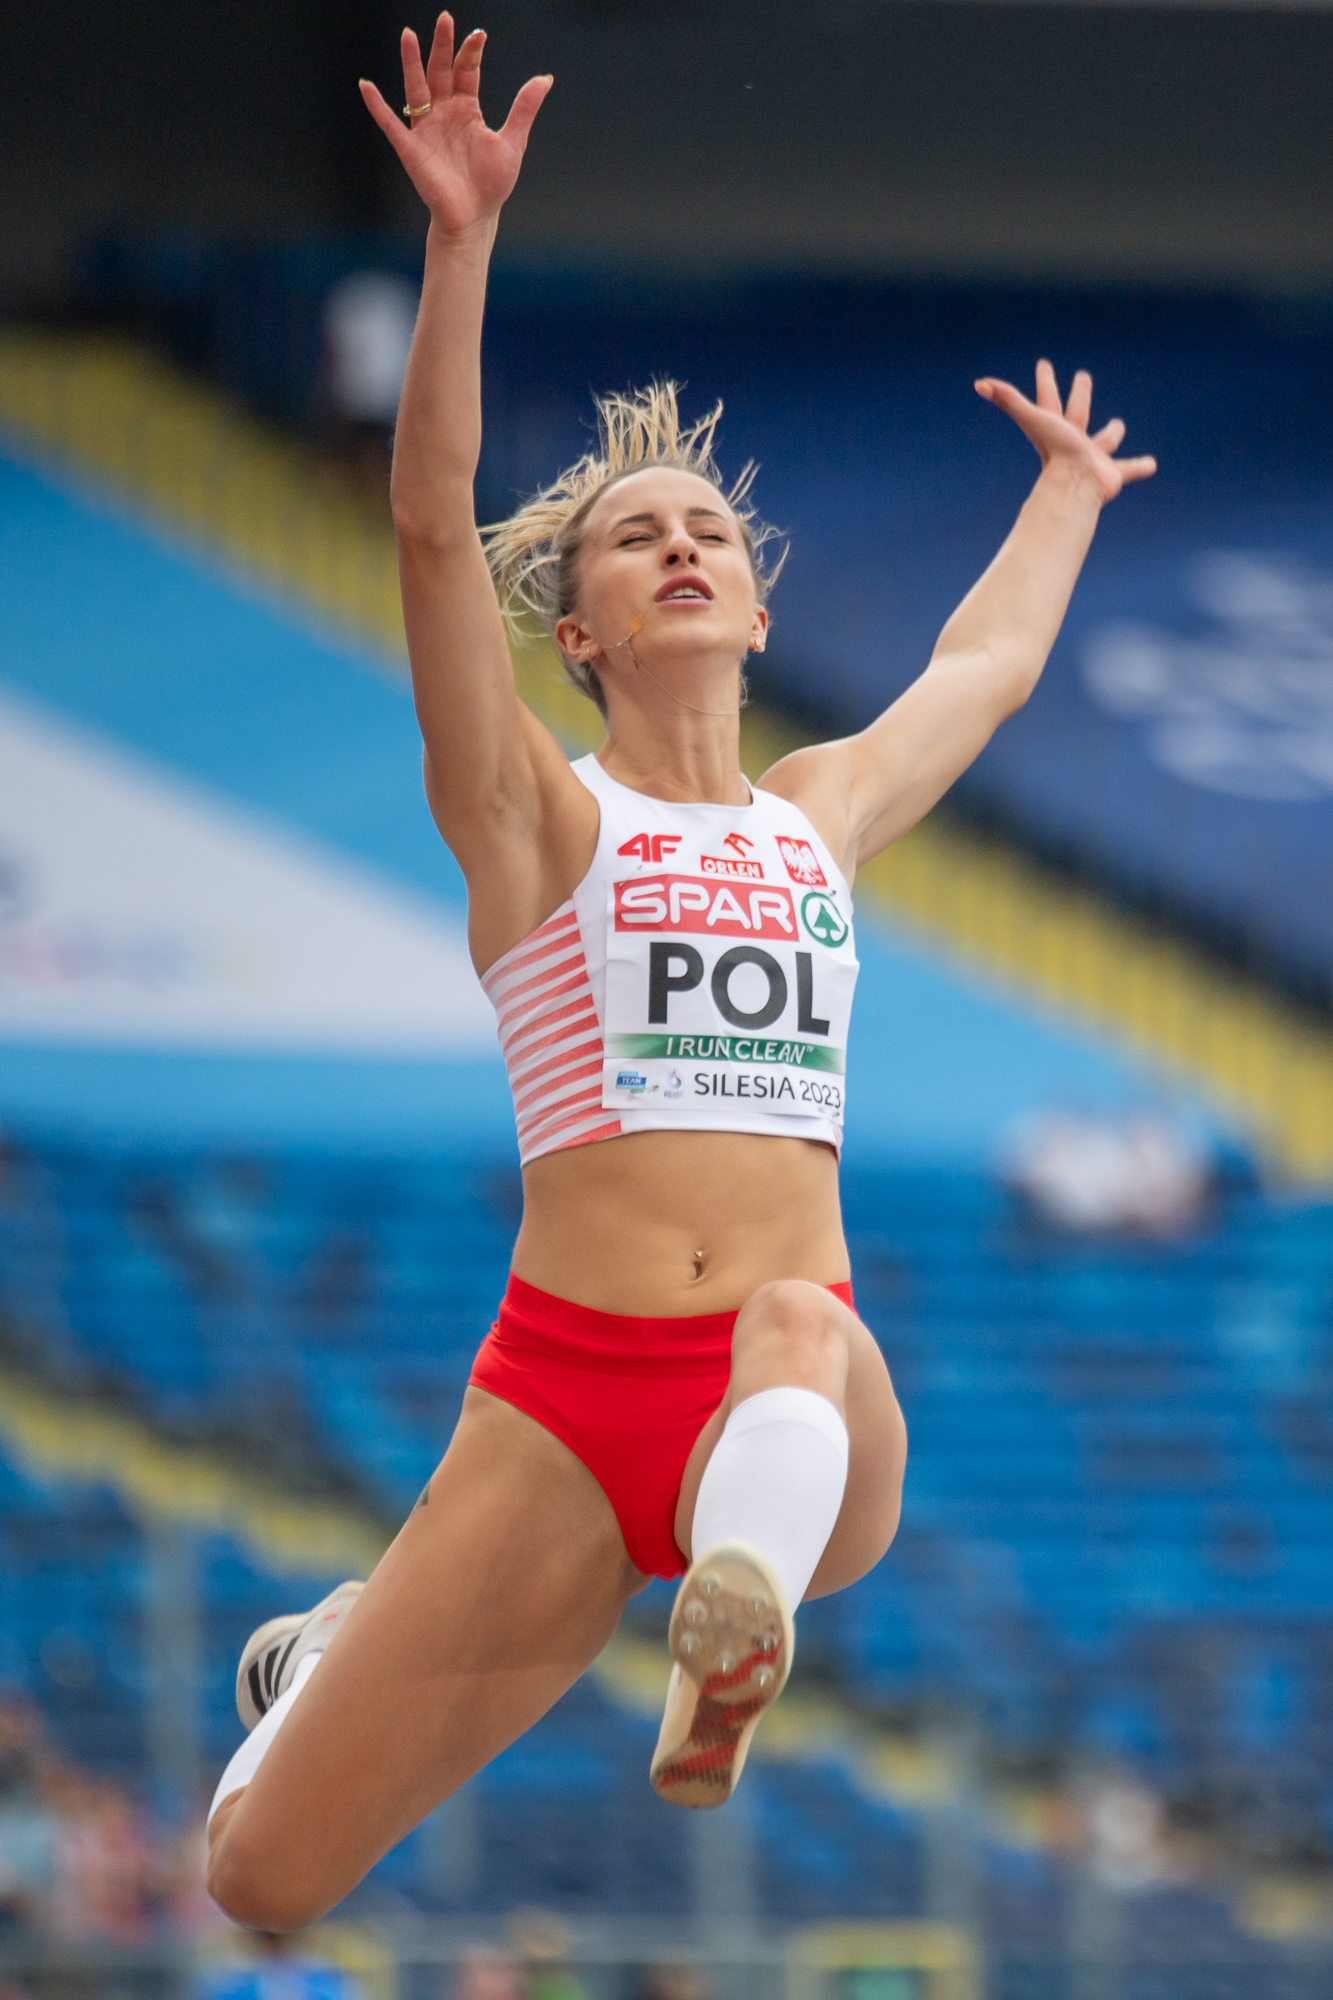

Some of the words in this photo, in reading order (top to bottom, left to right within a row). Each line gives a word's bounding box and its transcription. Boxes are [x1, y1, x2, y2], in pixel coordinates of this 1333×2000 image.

[617, 833, 682, 862] 4F
[703, 858, 760, 878] ORLEN
[620, 882, 794, 933] SPAR
[648, 942, 830, 1036] POL
[666, 1037, 673, 1056] I
[678, 1037, 730, 1059] RUN
[694, 1073, 795, 1100] SILESIA
[799, 1080, 841, 1109] 2023
